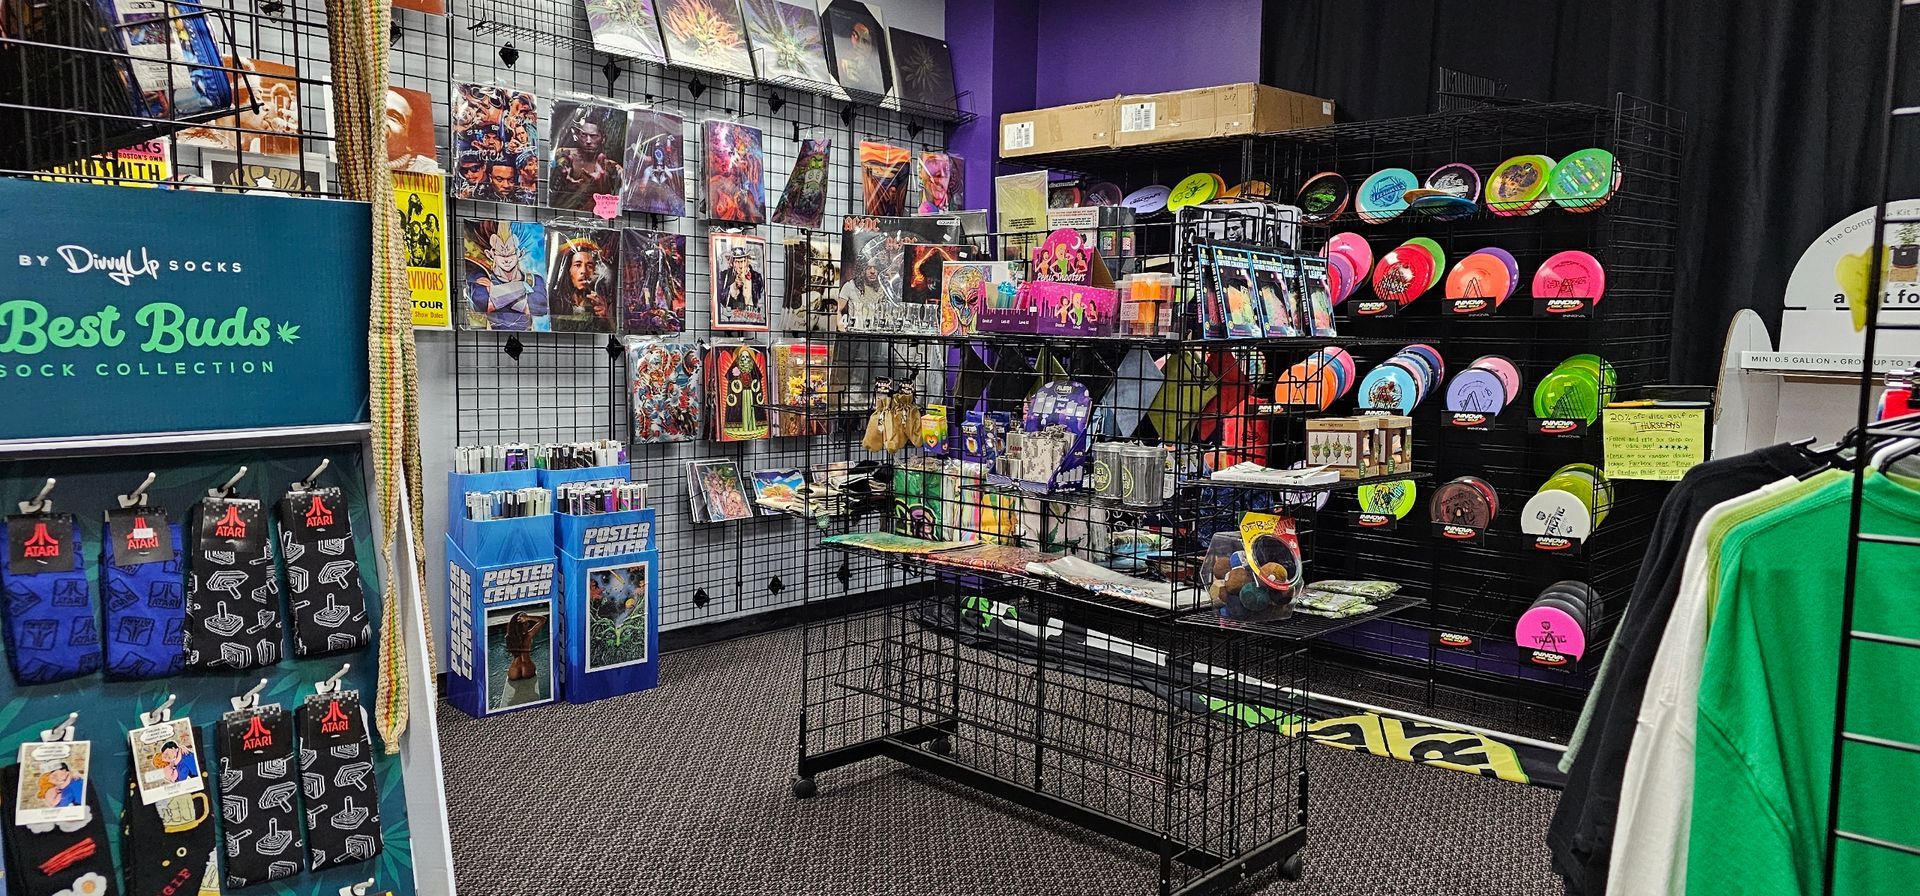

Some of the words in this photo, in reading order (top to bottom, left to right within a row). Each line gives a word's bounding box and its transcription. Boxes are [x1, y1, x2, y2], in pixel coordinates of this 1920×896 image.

[393, 172, 440, 193] SKYNYRD
[1826, 232, 1843, 247] The
[1897, 207, 1910, 217] Kit
[19, 255, 48, 266] BY
[57, 245, 159, 286] DivvyUp
[169, 260, 242, 273] SOCKS
[411, 300, 443, 309] TOUR
[0, 300, 125, 354] Best
[135, 302, 270, 354] Buds
[96, 361, 273, 376] COLLECTION
[1751, 355, 1772, 363] MINI
[1792, 357, 1831, 365] GALLON
[1840, 358, 1866, 366] GRO
[1873, 359, 1887, 367] UP
[1891, 359, 1905, 368] TO
[1609, 412, 1631, 421] 20%
[1668, 411, 1687, 422] golf
[306, 515, 333, 527] ATARI
[215, 527, 246, 538] ATARI
[583, 522, 650, 545] POSTER
[1444, 525, 1473, 533] INNOVA
[128, 537, 160, 550] ATARI
[24, 545, 60, 558] ATARI
[483, 563, 554, 588] POSTER
[483, 580, 552, 604] CENTER
[450, 560, 462, 677] POSTER
[459, 568, 473, 681] CENTER
[1441, 632, 1468, 641] INNOVA
[1533, 651, 1565, 660] INNOVA
[321, 721, 350, 734] ATARI
[243, 735, 273, 751] ATARI
